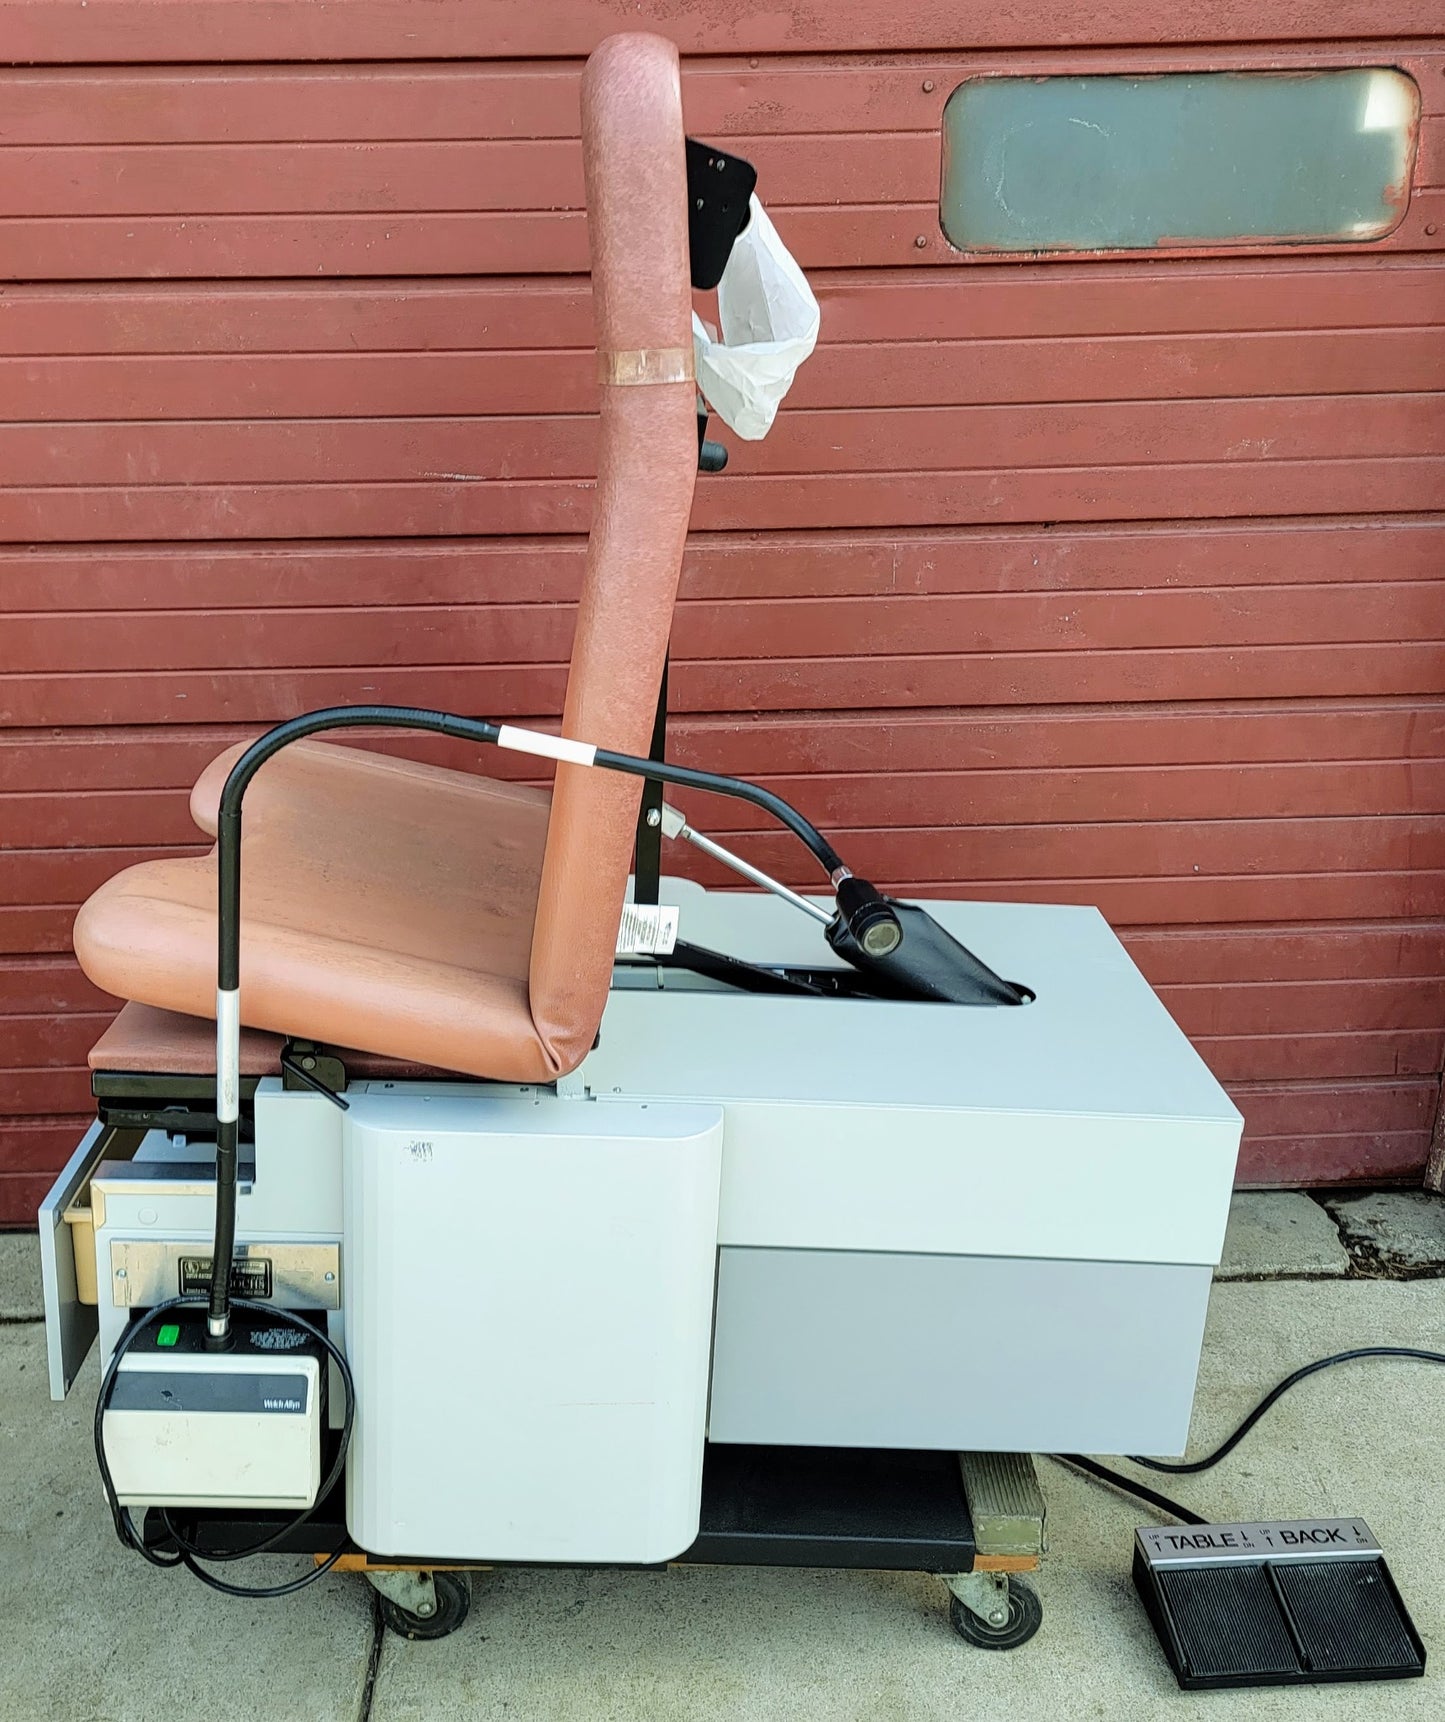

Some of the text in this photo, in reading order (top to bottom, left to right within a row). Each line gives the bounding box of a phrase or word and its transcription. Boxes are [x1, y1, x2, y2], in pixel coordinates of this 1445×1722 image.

[264, 1398, 301, 1411] Welch Allyn
[1164, 1532, 1239, 1550] TABLE
[1279, 1528, 1348, 1545] BACK
